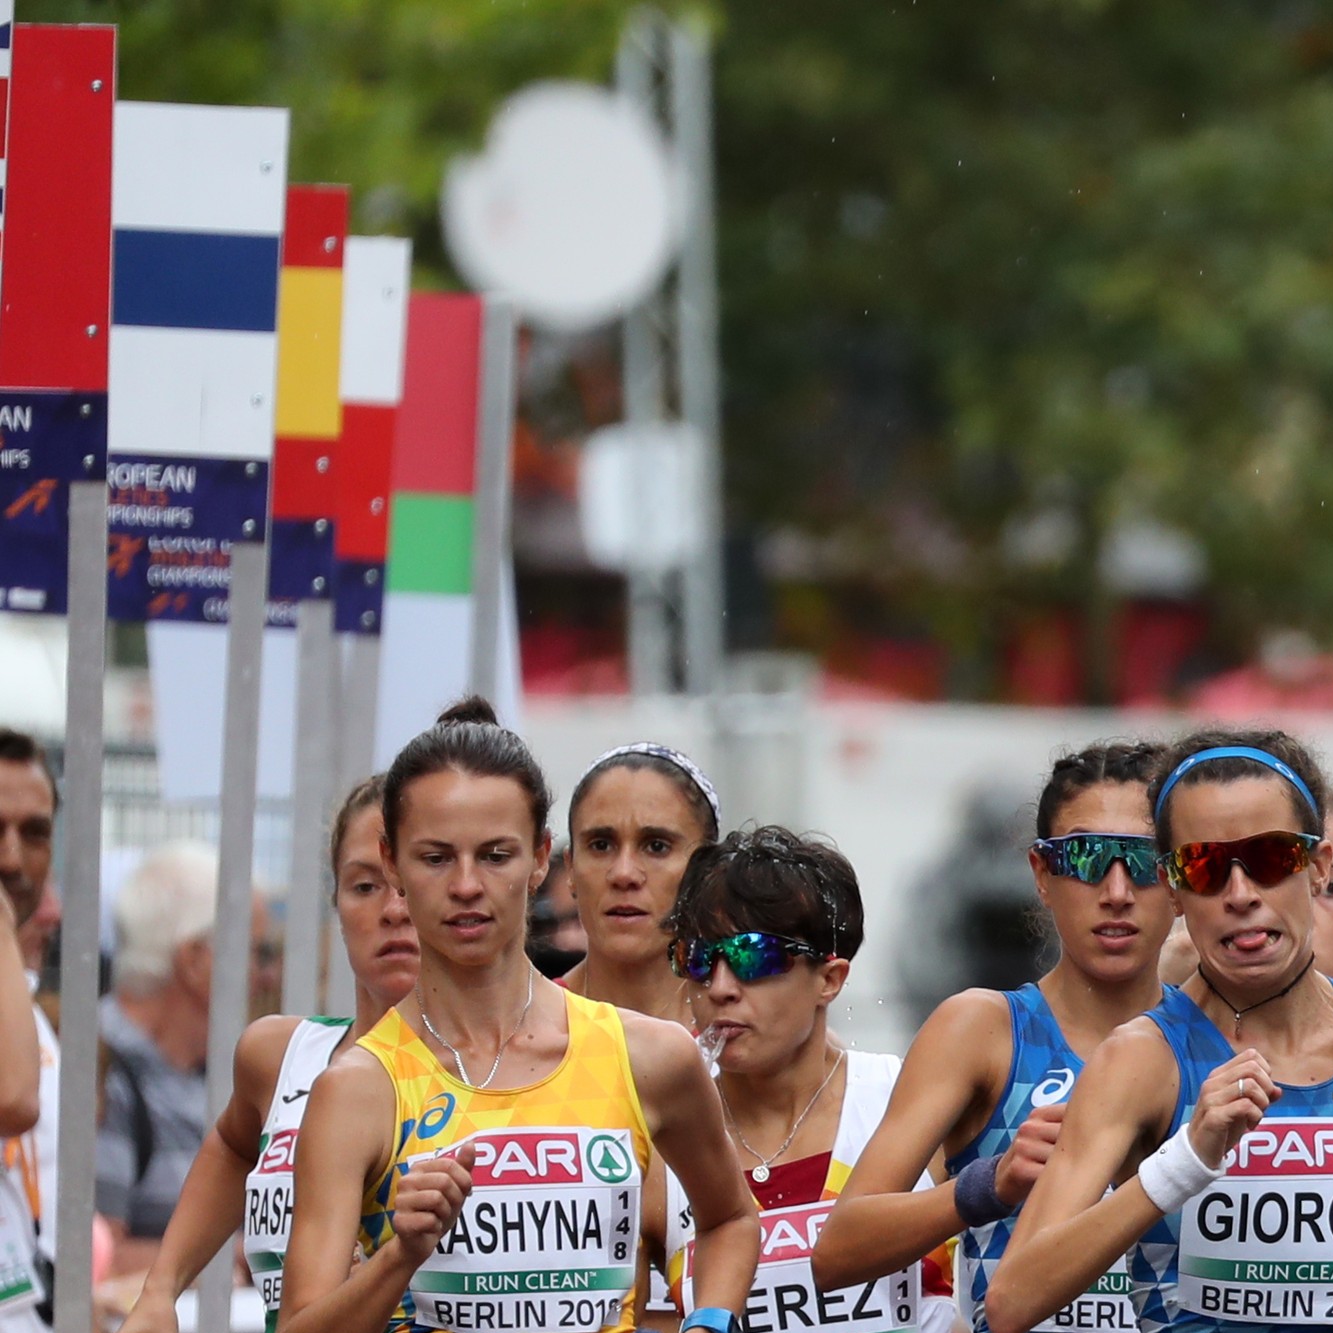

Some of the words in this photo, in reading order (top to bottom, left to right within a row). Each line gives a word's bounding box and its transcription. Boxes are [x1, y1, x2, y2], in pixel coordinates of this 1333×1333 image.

[107, 462, 197, 493] ROPEAN
[473, 1139, 578, 1179] PAR
[435, 1199, 602, 1255] ASHYNA
[475, 1274, 519, 1292] RUN
[1246, 1263, 1292, 1280] RUN
[896, 1265, 911, 1323] 10
[1201, 1285, 1313, 1317] BERLIN
[434, 1299, 547, 1329] BERLIN
[1055, 1301, 1136, 1329] BERL
